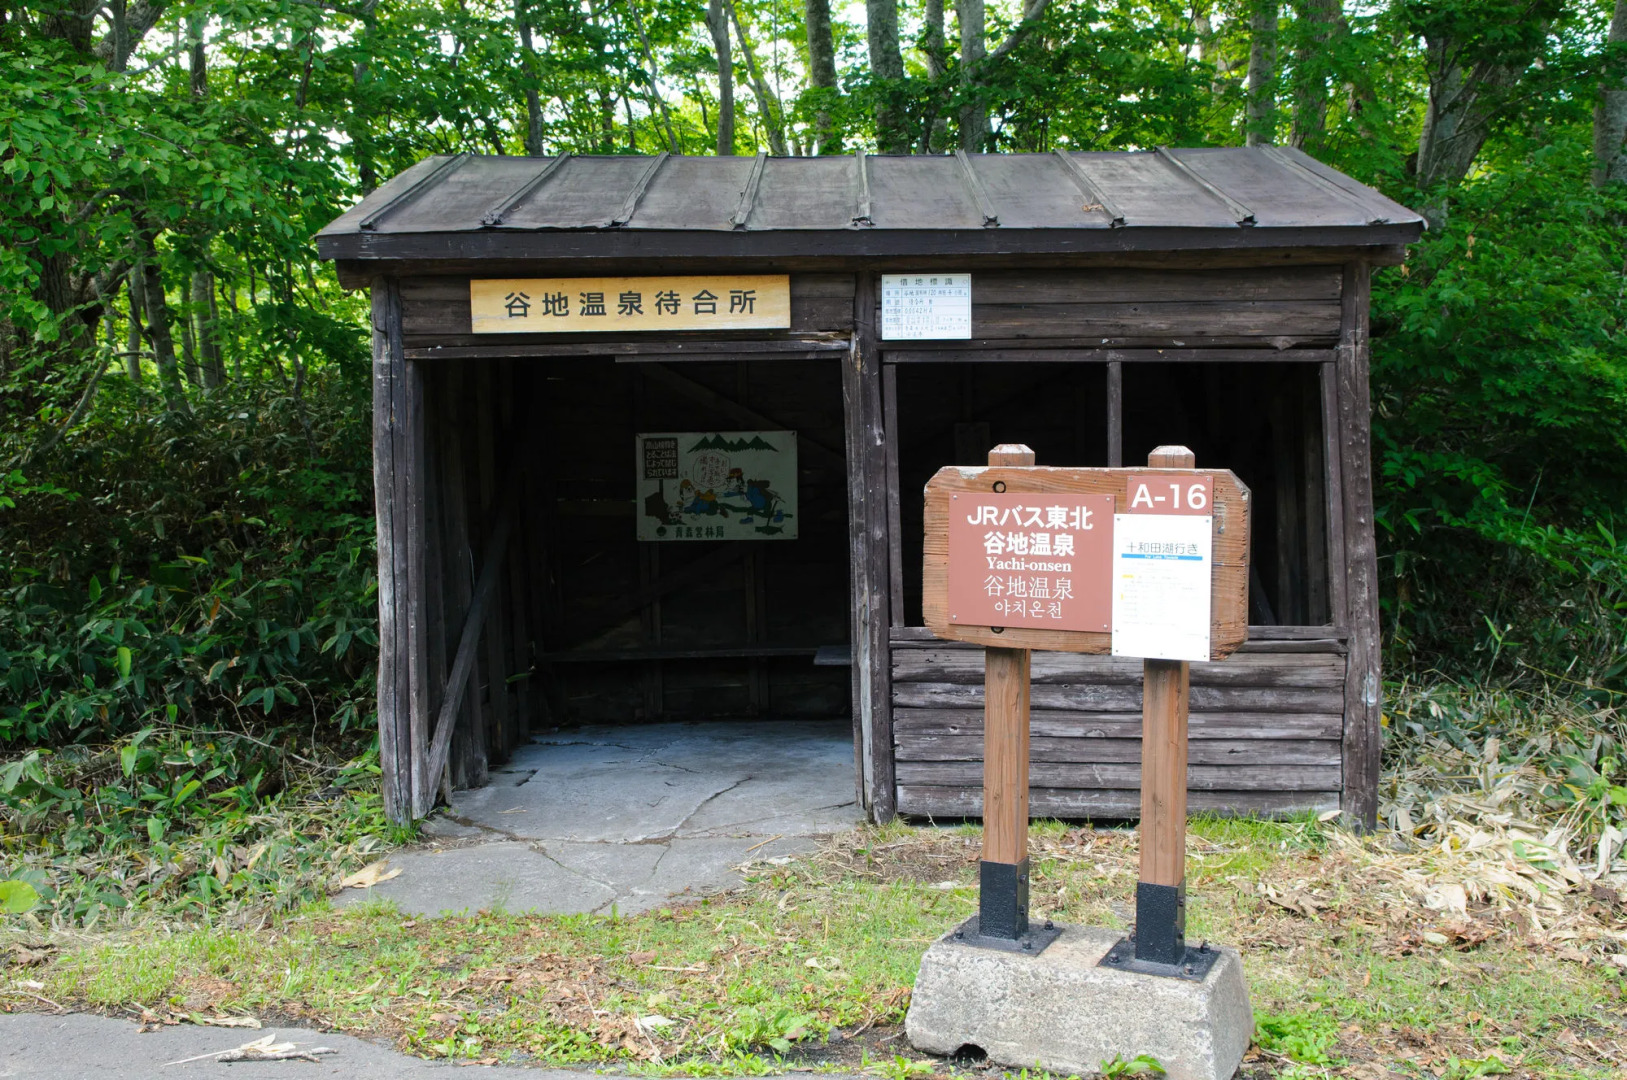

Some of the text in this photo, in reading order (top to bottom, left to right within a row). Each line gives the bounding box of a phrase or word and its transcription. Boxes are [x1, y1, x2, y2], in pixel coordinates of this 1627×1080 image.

[504, 289, 757, 318] 谷地温泉待合所
[1130, 483, 1207, 510] A-16
[966, 505, 1094, 531] JRバス東北
[675, 526, 724, 538] 青森営林局
[983, 532, 1076, 557] 谷地温泉
[1126, 541, 1199, 556] 十和田湖行き
[985, 556, 1073, 573] Yachi-onsen
[983, 574, 1075, 600] 谷地温泉
[993, 599, 1063, 619] 야치온천
